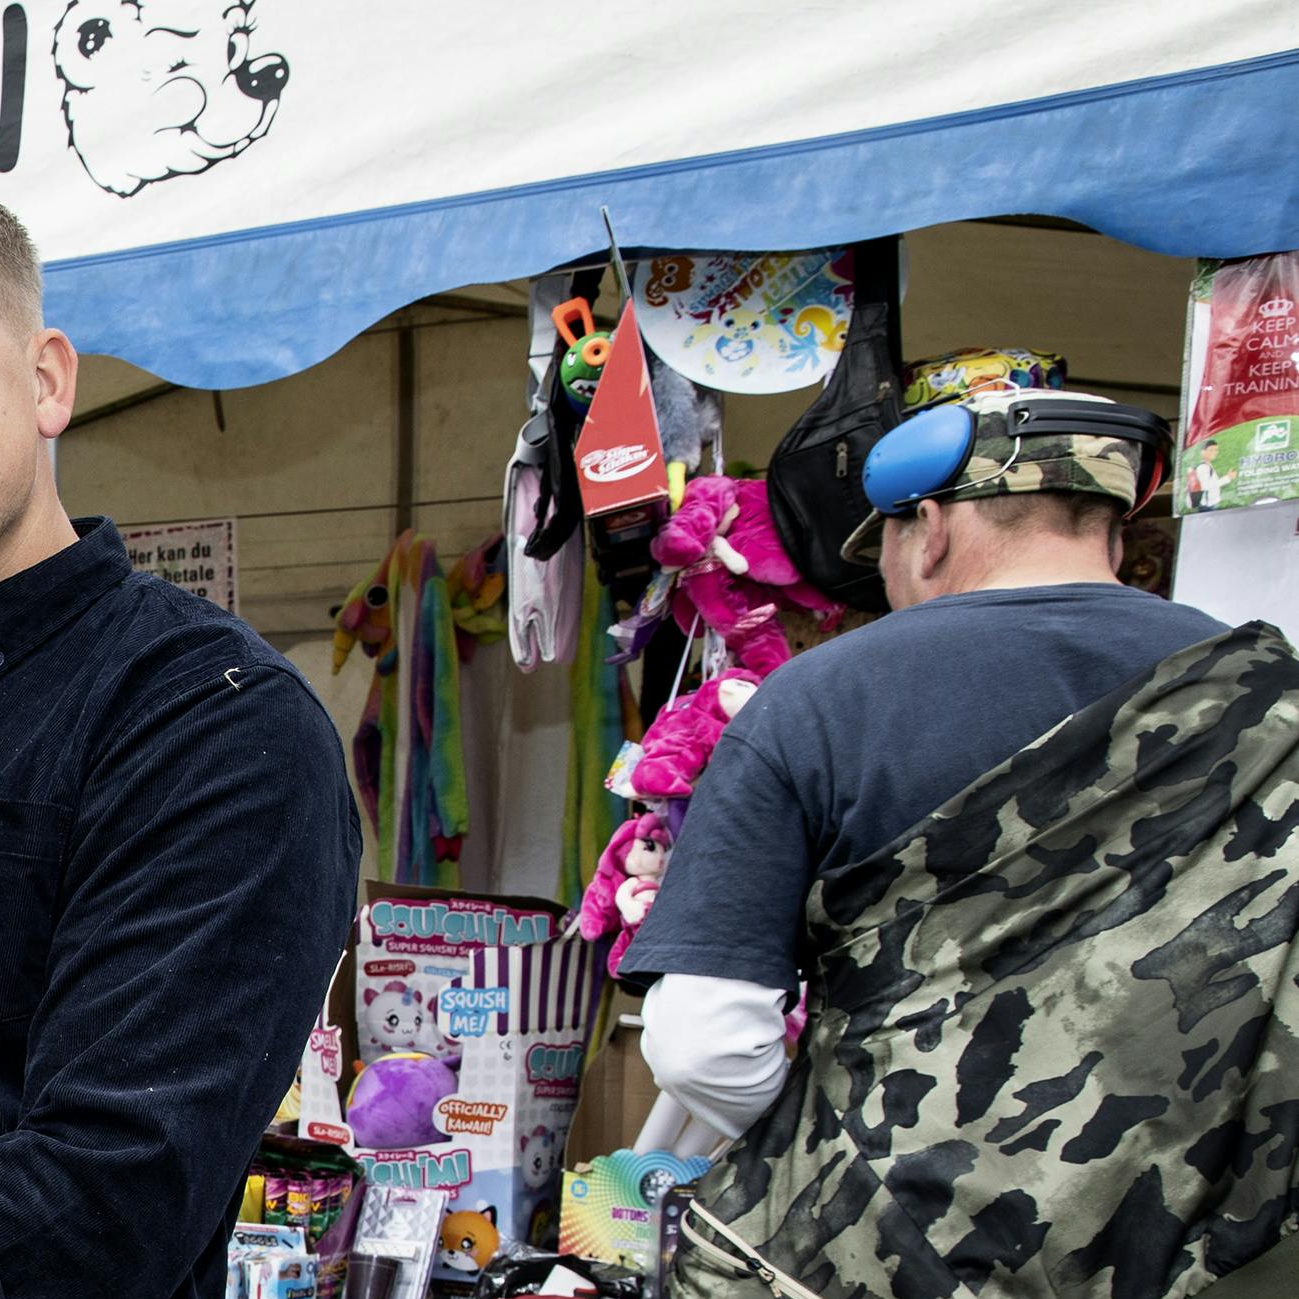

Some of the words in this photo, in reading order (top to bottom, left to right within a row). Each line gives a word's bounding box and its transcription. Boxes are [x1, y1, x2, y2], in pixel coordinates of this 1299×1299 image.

[1252, 316, 1296, 333] KEEP
[1258, 350, 1284, 360] AND
[1248, 360, 1292, 378] KEEP
[1225, 376, 1299, 396] TRAININ
[129, 548, 153, 565] Her
[157, 545, 186, 562] kan
[191, 542, 212, 559] du
[442, 990, 507, 1010] SQUISH
[452, 1013, 487, 1034] ME!
[439, 1100, 508, 1121] OFFICIALLY
[447, 1117, 494, 1135] KAWAII!
